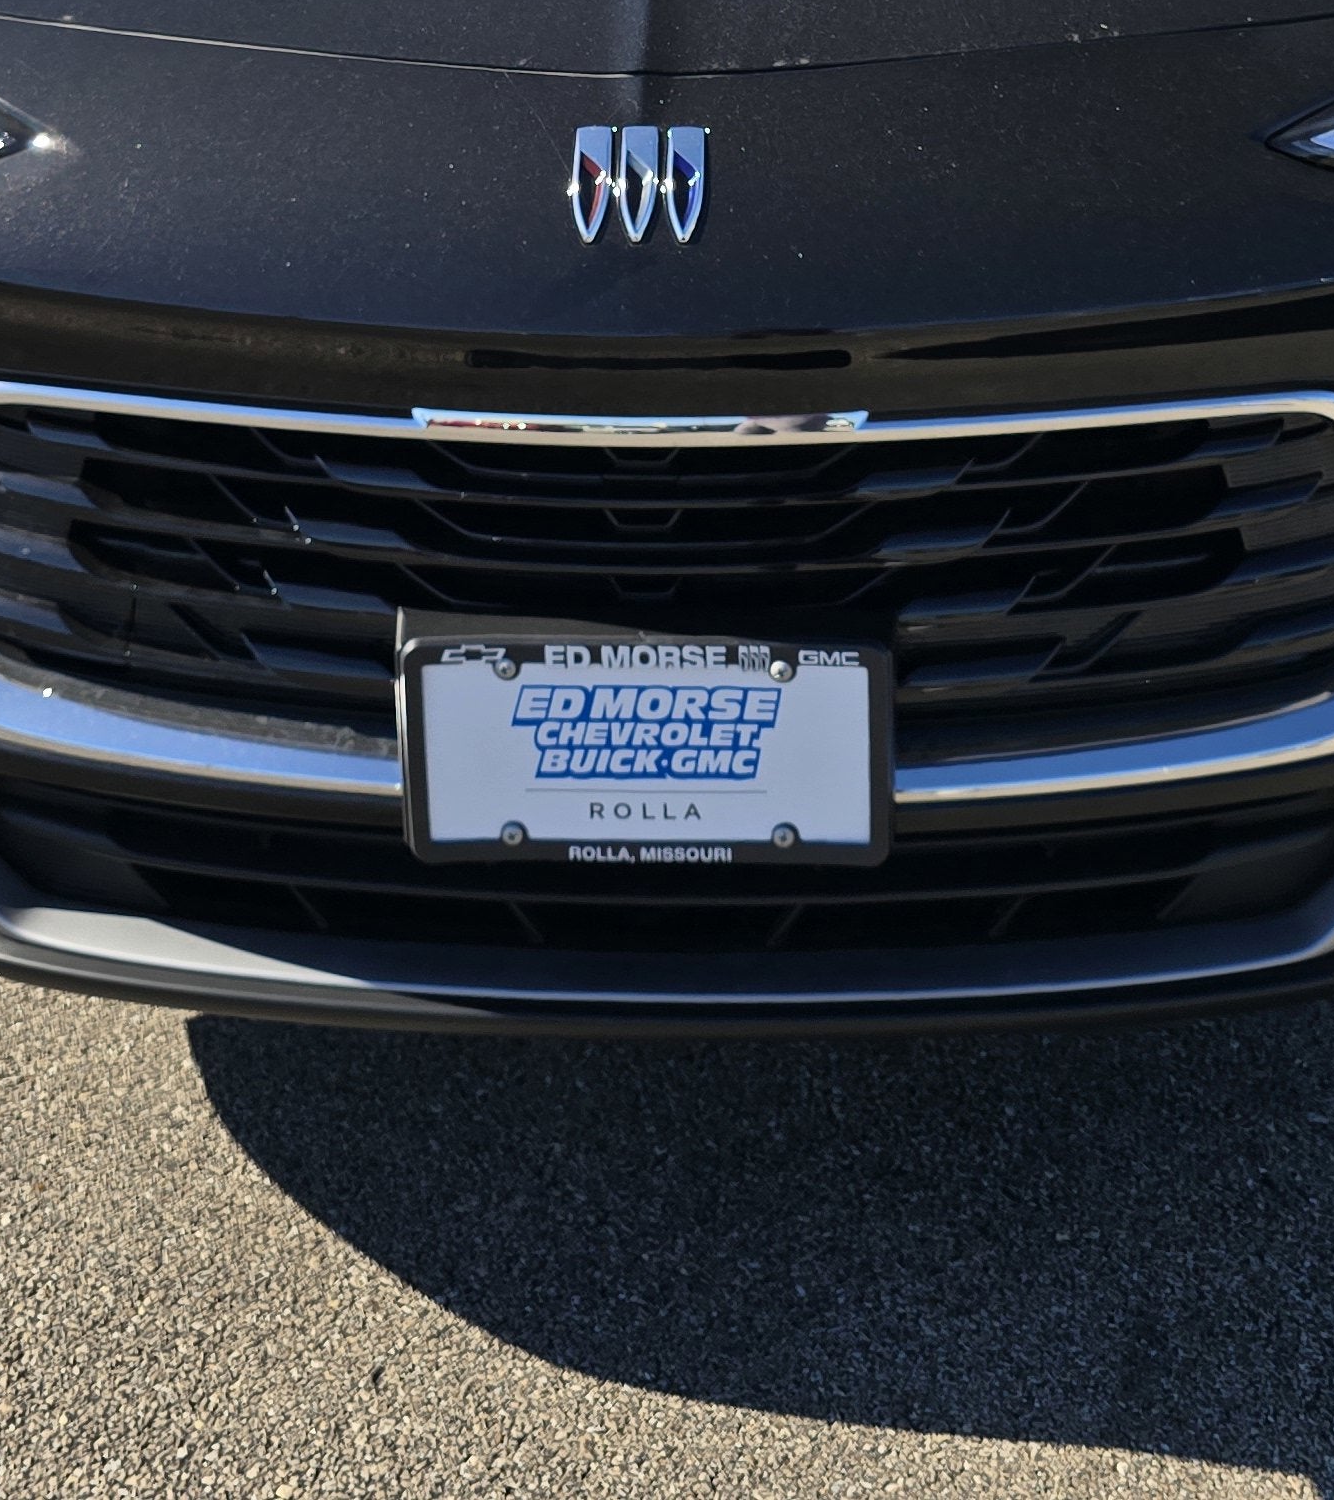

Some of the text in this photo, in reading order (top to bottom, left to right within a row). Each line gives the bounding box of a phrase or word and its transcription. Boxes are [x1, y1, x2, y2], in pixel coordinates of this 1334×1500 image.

[544, 645, 860, 670] ED MORSE GMC
[516, 688, 779, 721] ED MORSE
[537, 722, 761, 747] CHEVROLET
[589, 802, 702, 820] ROLLA
[568, 846, 733, 864] ROLLA, MISSOURI
